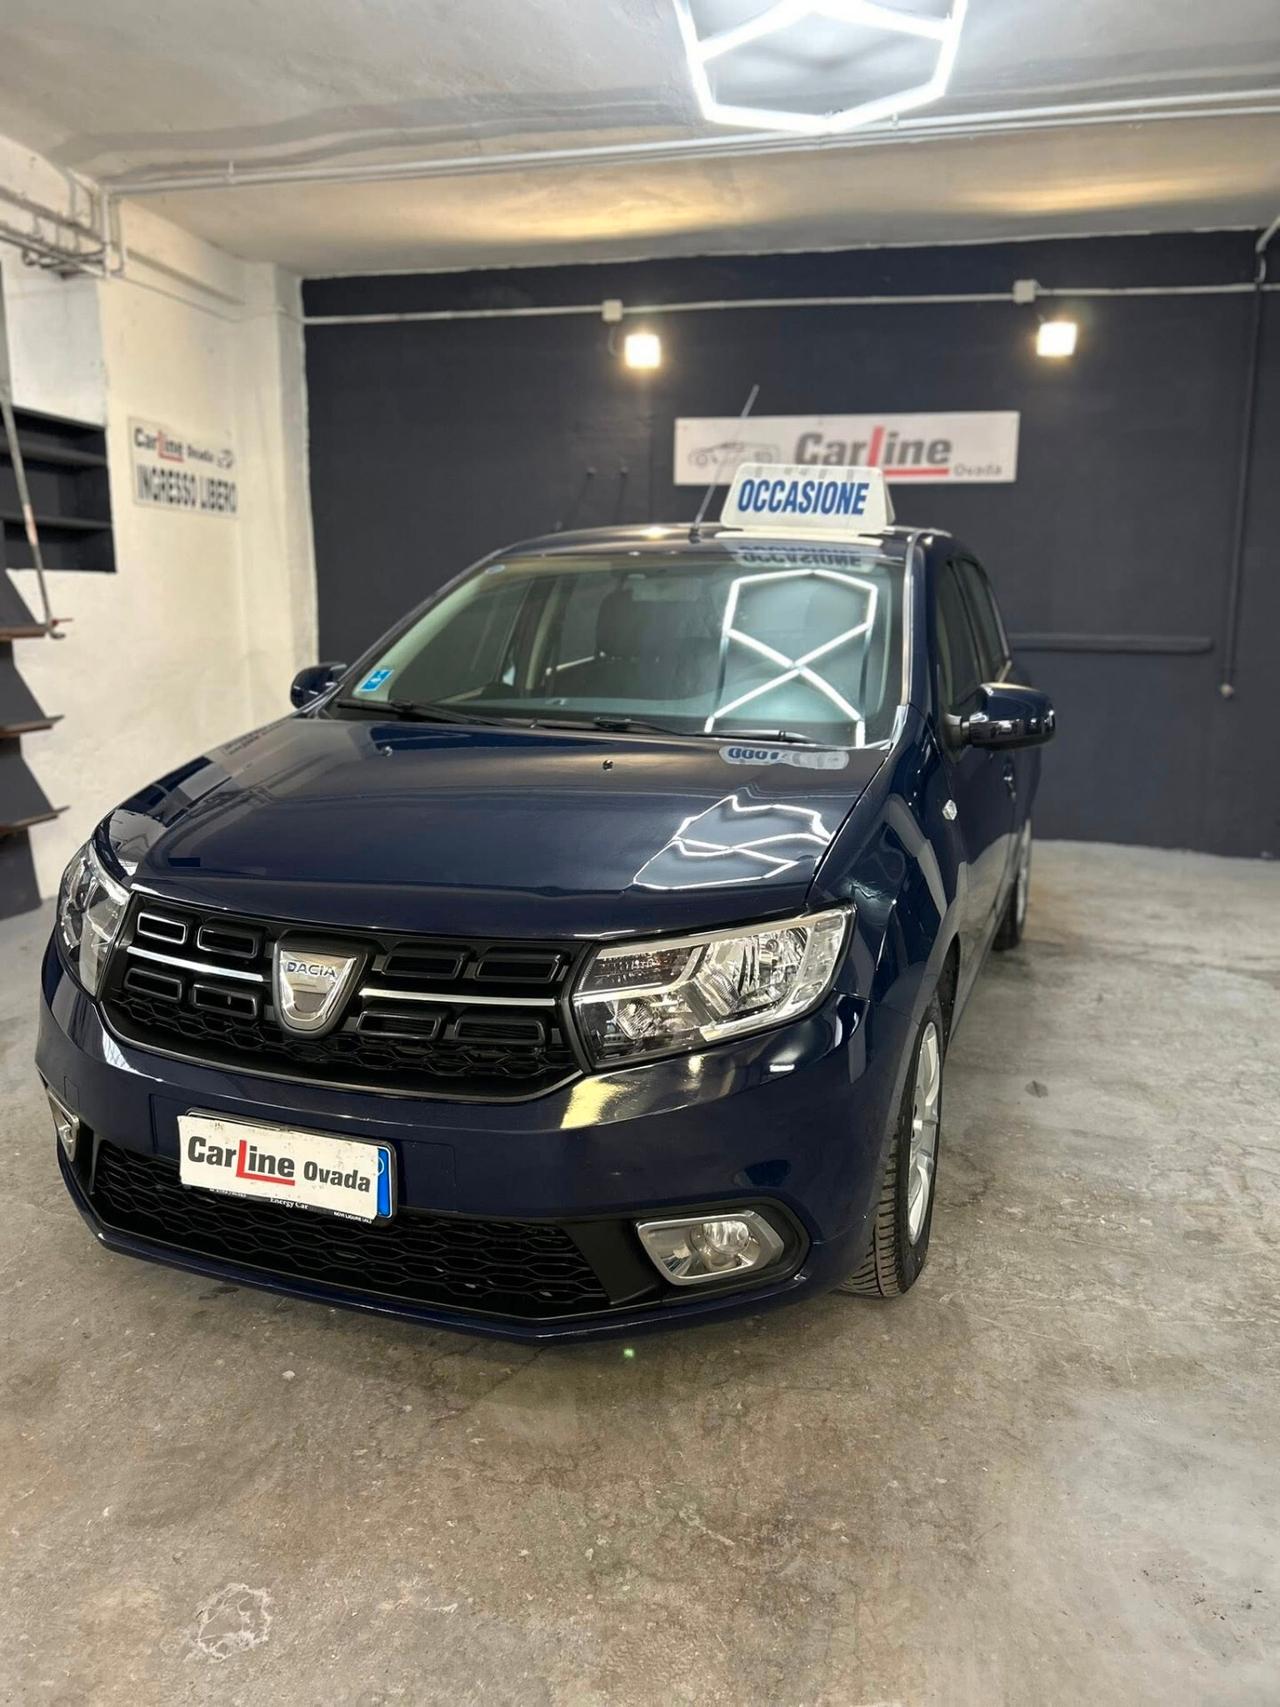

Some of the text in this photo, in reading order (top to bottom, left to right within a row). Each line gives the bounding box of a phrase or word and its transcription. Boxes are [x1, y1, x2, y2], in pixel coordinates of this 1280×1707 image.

[137, 464, 236, 514] INGRESSO LIBERO
[737, 479, 869, 515] OCCASIONE
[287, 961, 337, 978] DACIA
[303, 1161, 371, 1193] Ovada
